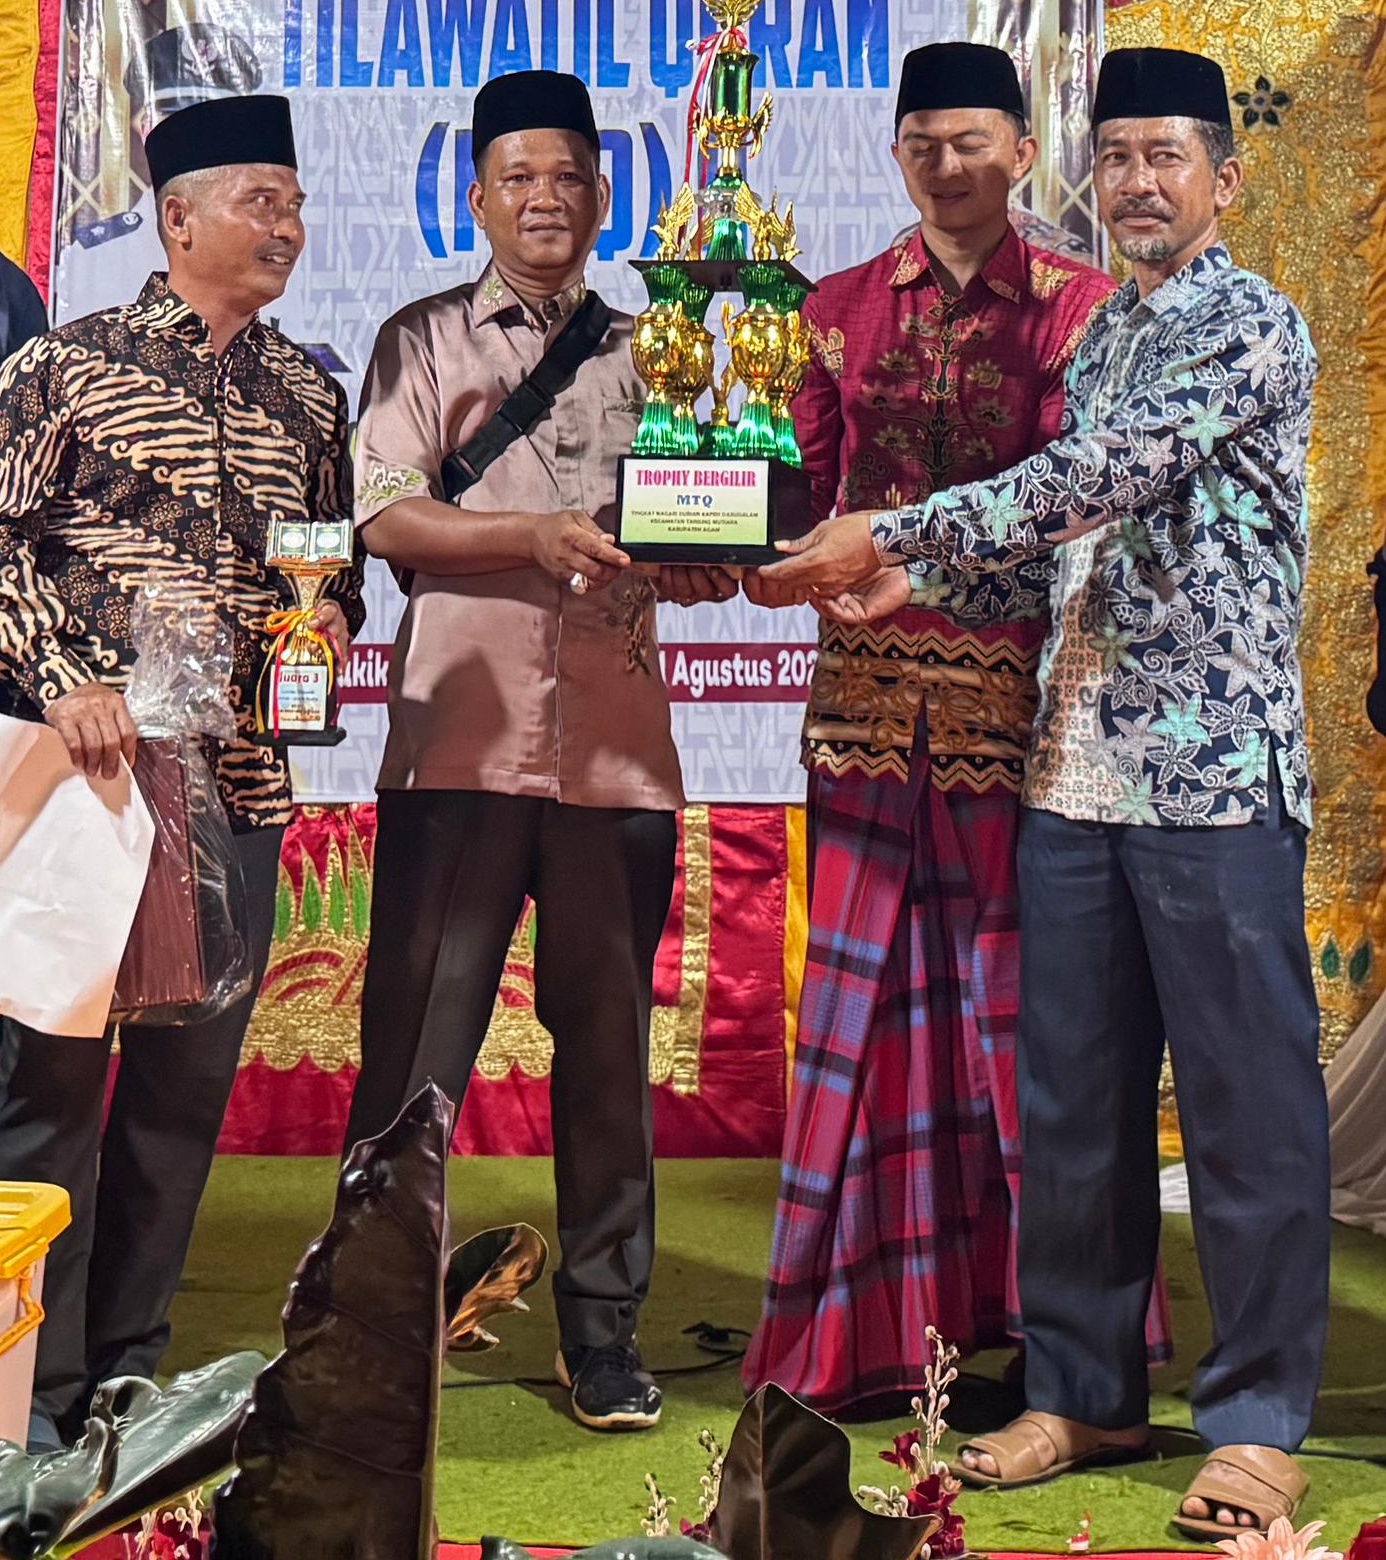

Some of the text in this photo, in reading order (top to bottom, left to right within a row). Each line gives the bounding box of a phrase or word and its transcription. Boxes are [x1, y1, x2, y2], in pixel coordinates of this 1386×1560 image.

[415, 121, 673, 262] (Q)
[636, 469, 756, 487] TROPHY BERGILIR
[676, 494, 713, 508] MTQ
[312, 672, 319, 683] 3
[336, 648, 389, 687] ukik
[671, 650, 772, 698] Agustus
[777, 649, 819, 687] 202
